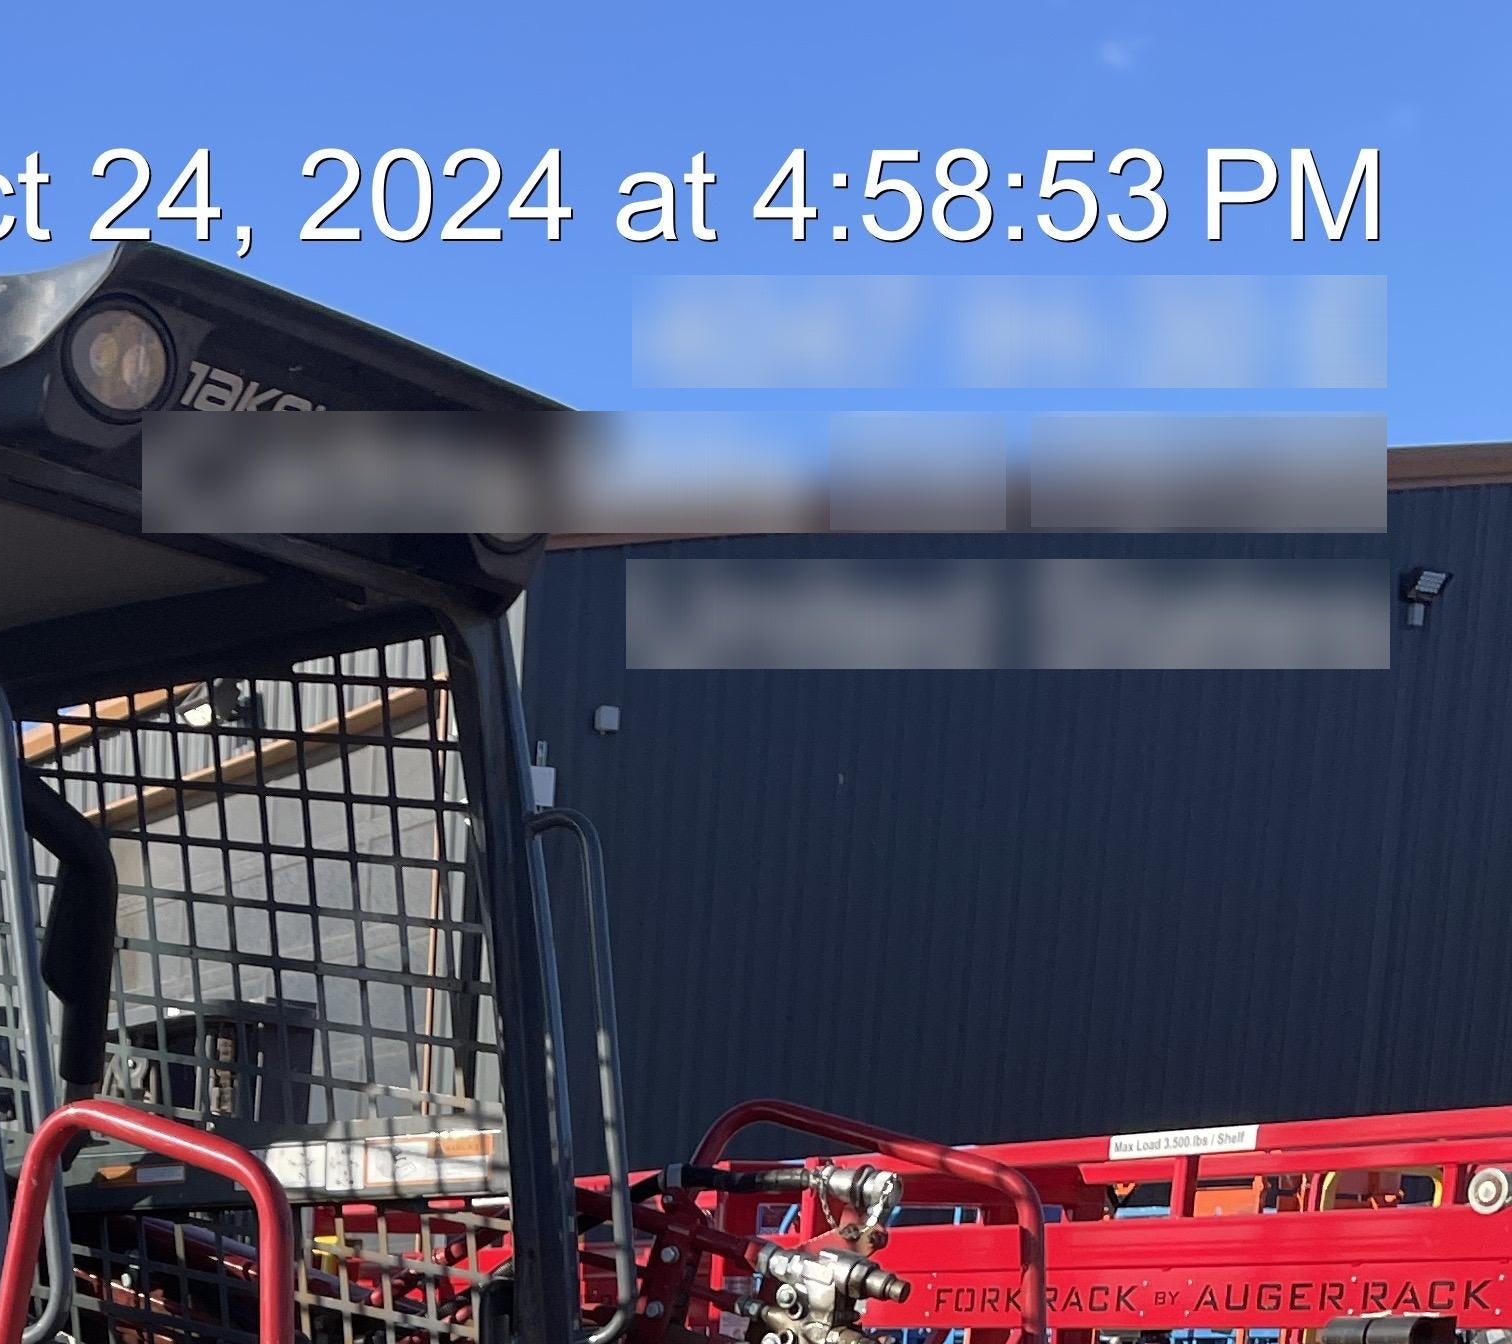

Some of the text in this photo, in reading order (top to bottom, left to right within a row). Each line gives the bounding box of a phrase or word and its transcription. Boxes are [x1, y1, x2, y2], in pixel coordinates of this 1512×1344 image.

[1114, 1140, 1134, 1152] Max
[1137, 1138, 1161, 1151] Load
[1217, 1130, 1245, 1145] Shelf
[934, 1287, 1022, 1313] FORK
[1154, 1291, 1180, 1306] BY
[1193, 1281, 1345, 1312] AUGER
[1361, 1279, 1492, 1311] RACK
